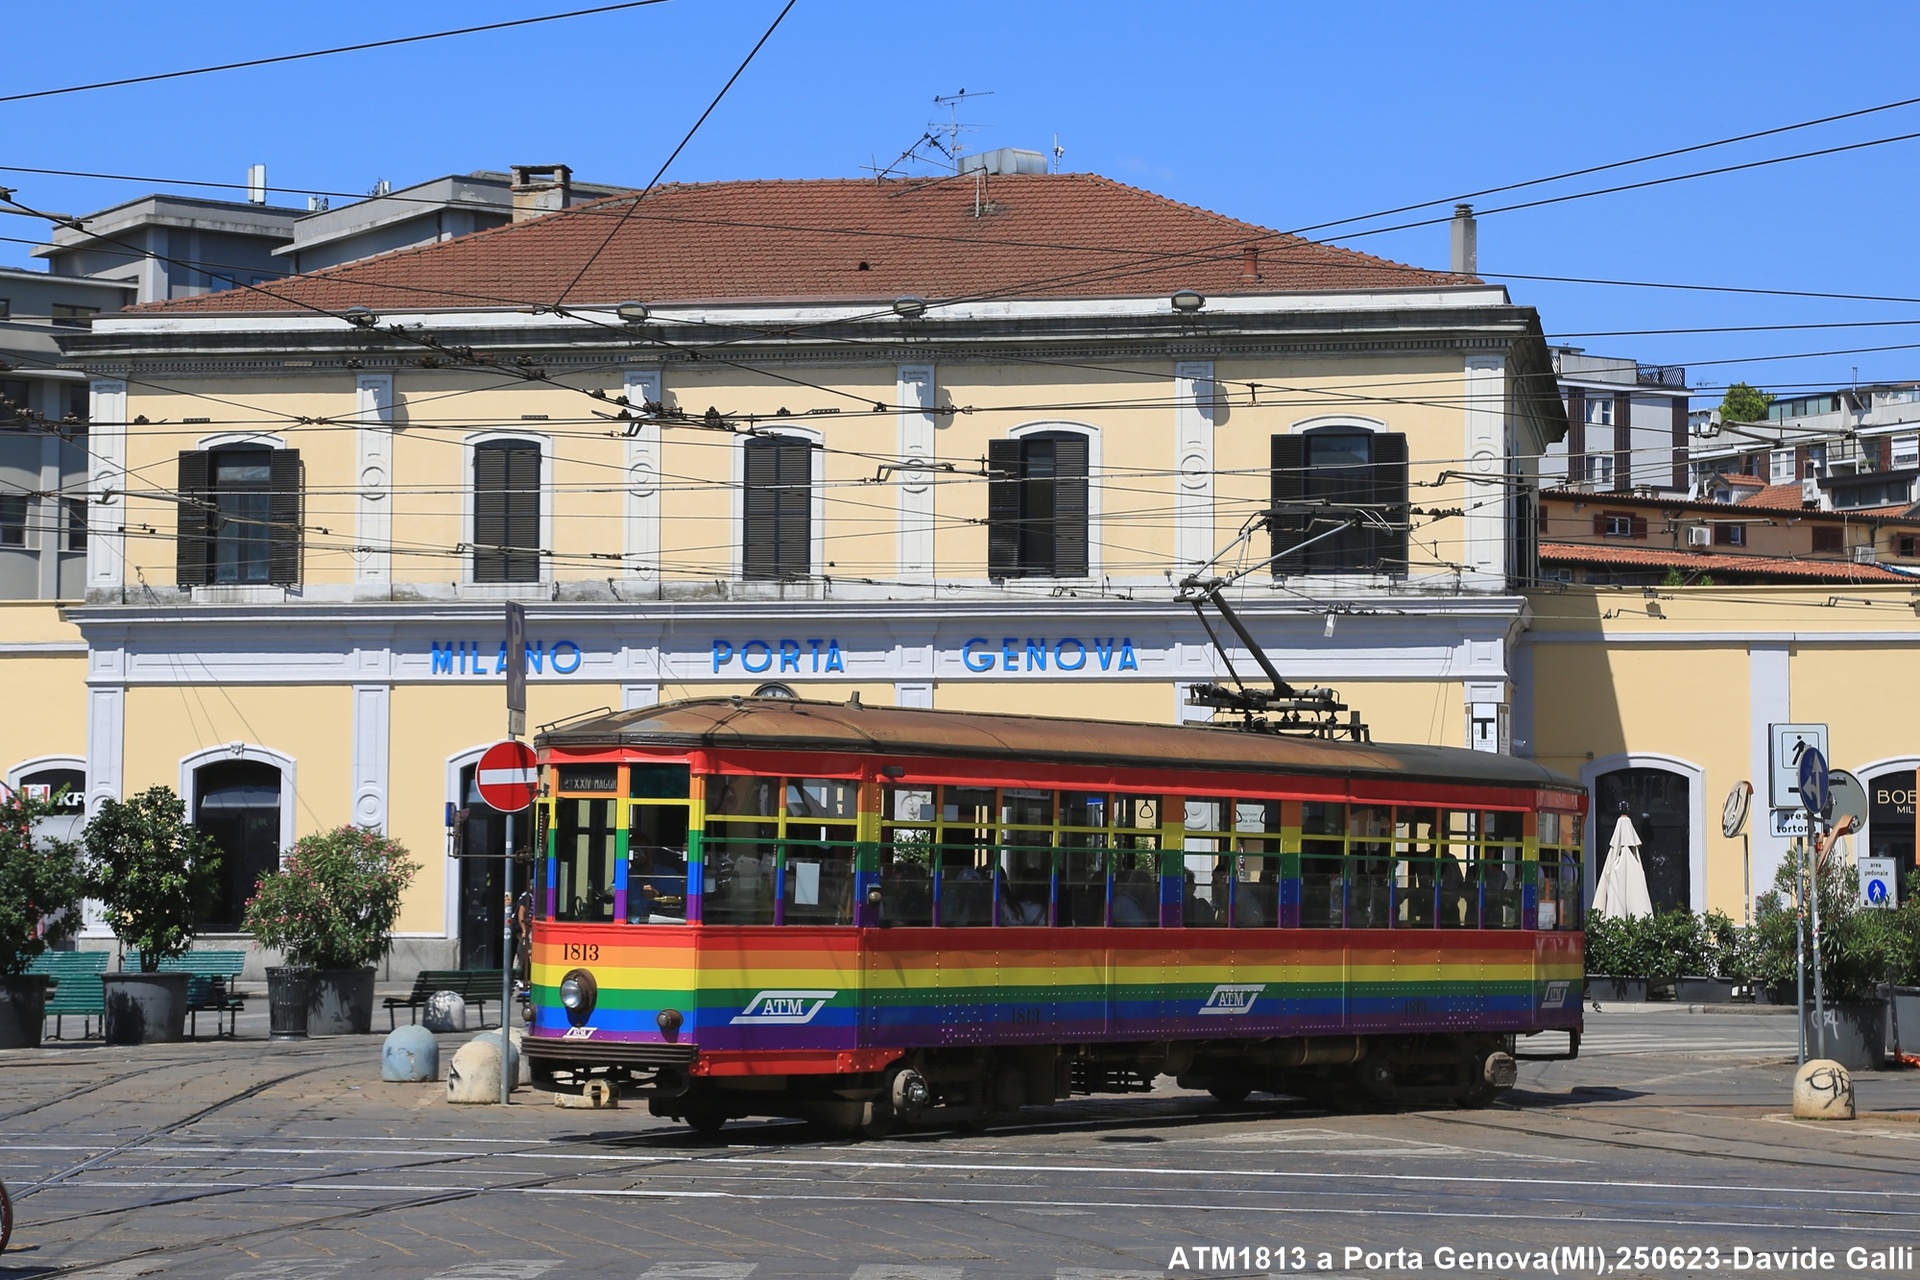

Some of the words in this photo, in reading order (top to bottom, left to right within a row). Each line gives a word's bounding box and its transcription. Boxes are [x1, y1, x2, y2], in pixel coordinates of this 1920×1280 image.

[431, 640, 582, 674] MILANO
[712, 639, 845, 673] PORTA
[962, 637, 1139, 672] GENOVA
[1472, 718, 1495, 739] T
[56, 791, 86, 806] KF
[1864, 869, 1889, 877] pedonale
[563, 943, 599, 961] 1813
[761, 999, 804, 1015] ATM
[1218, 992, 1245, 1006] ATM
[1011, 1007, 1040, 1025] 1813
